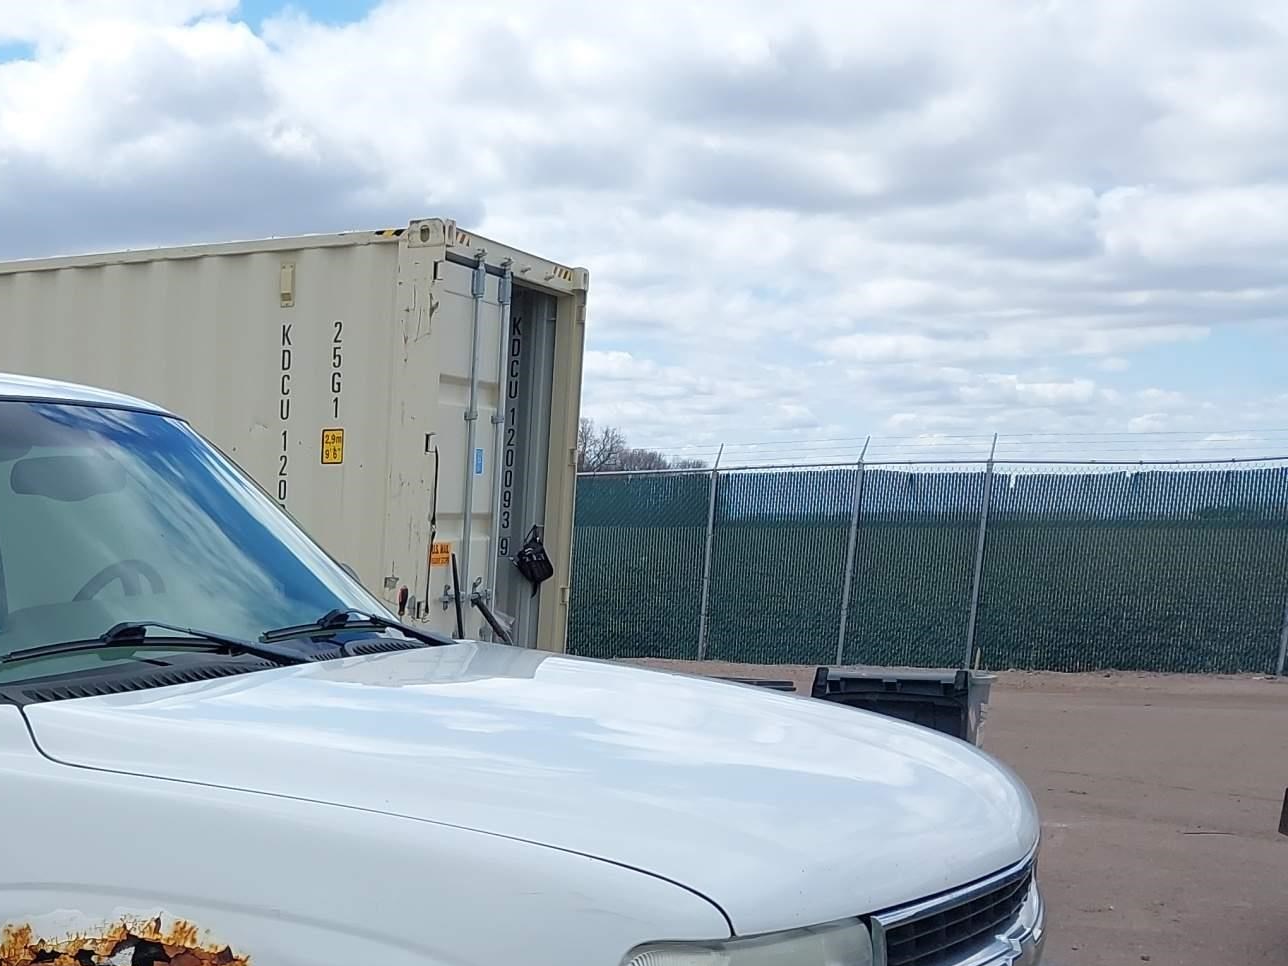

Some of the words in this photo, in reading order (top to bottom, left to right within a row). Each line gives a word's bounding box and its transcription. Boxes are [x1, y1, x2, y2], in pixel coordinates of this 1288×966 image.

[279, 323, 292, 420] KDCU
[331, 321, 343, 419] 25G1
[508, 316, 522, 399] KDCU
[278, 430, 288, 509] 120
[502, 407, 516, 529] 120093
[499, 538, 510, 556] 9
